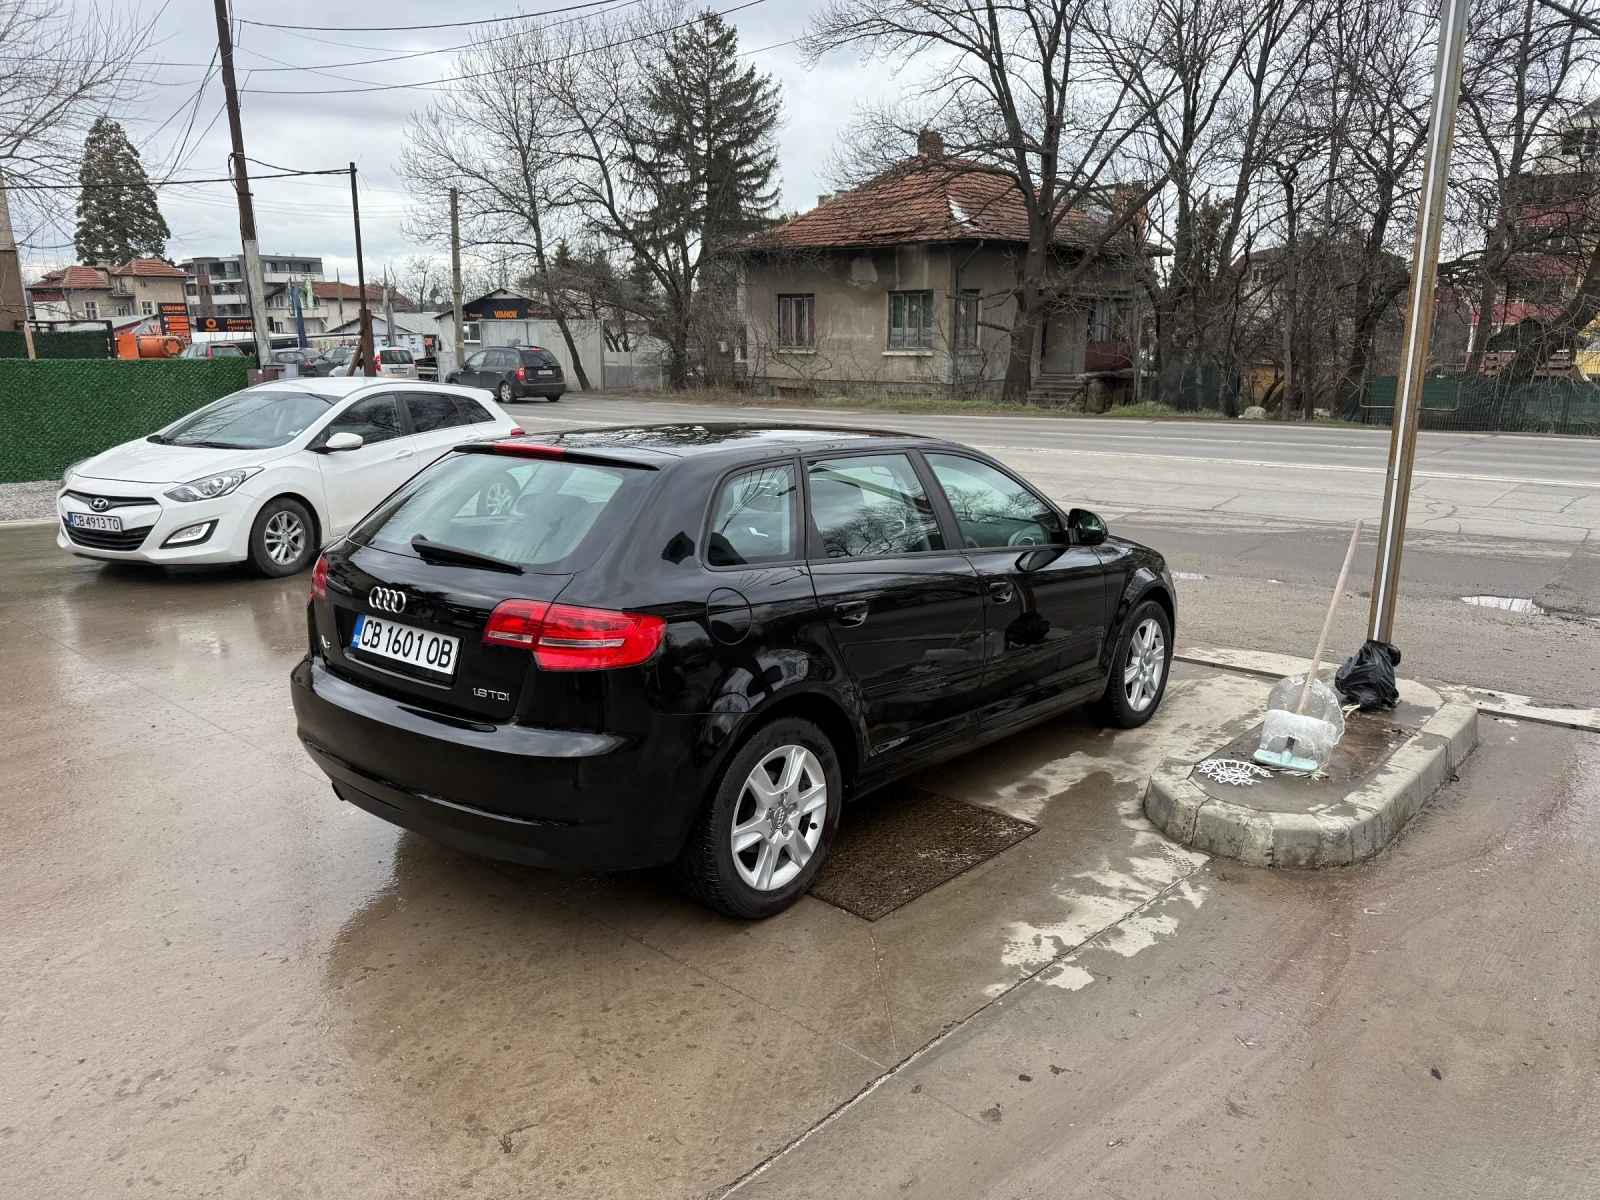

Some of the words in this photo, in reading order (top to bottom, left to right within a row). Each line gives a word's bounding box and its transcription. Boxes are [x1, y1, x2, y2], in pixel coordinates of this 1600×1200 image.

[494, 310, 518, 319] VIANOR
[73, 515, 85, 527] CB
[86, 516, 107, 529] 4913
[361, 619, 383, 649] CB
[385, 625, 425, 661] 1601
[426, 636, 453, 668] OB
[488, 689, 510, 702] TDI
